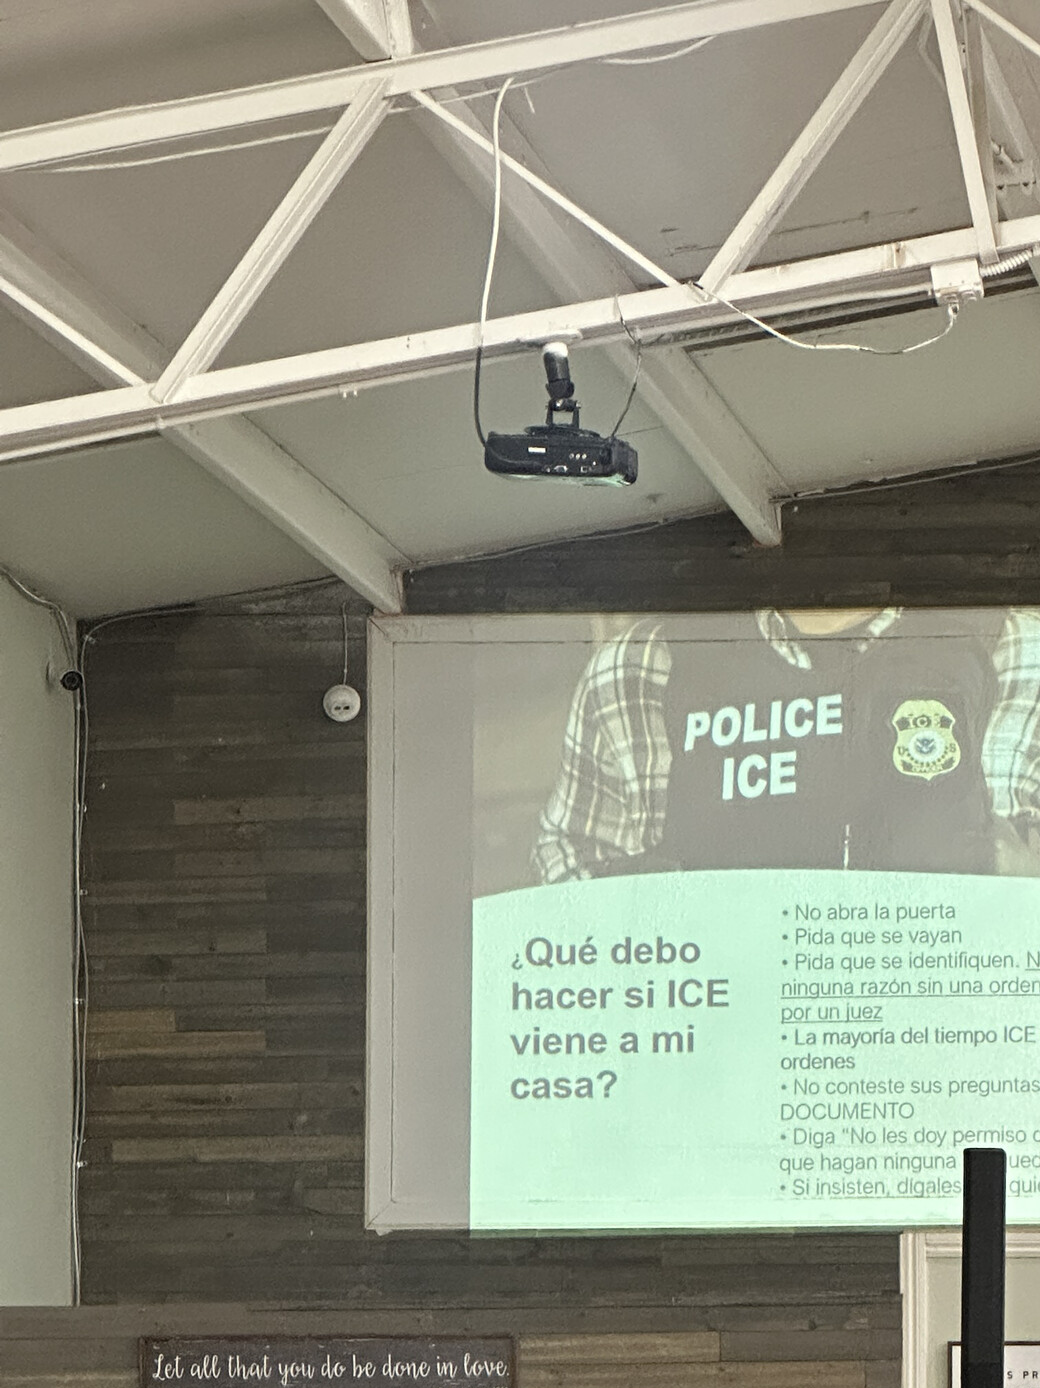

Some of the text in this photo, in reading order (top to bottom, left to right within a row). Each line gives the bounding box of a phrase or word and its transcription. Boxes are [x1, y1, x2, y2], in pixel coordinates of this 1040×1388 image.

[683, 694, 843, 751] POLICE
[722, 751, 797, 800] ICE
[795, 904, 956, 923] No abra la puerta
[795, 928, 962, 948] Pida que se vayan
[512, 936, 701, 970] ¿Qué debo
[795, 953, 835, 970] Pida
[841, 956, 876, 973] que
[881, 956, 903, 968] se
[909, 951, 1020, 972] identifiquen.
[512, 979, 729, 1010] hacer si ICE
[781, 979, 853, 998] ninguna
[860, 977, 911, 994] razón
[917, 976, 942, 993] sin
[950, 980, 982, 993] una
[781, 1004, 883, 1023] por un juez
[510, 1024, 694, 1055] viene a mi
[794, 1028, 816, 1045] La
[823, 1027, 895, 1047] mayoría
[901, 1027, 928, 1044] del
[934, 1027, 997, 1046] tiempo
[1003, 1026, 1036, 1043] ICE
[780, 1053, 856, 1070] ordenes
[510, 1070, 618, 1099] casa?
[793, 1078, 820, 1095] No
[825, 1078, 904, 1094] conteste
[910, 1080, 942, 1093] sus
[780, 1102, 915, 1121] DOCUMENTO
[793, 1128, 835, 1148] Diga
[882, 1127, 907, 1143] les
[913, 1127, 947, 1147] doy
[953, 1127, 1027, 1148] permiso
[780, 1155, 814, 1174] que
[821, 1154, 877, 1174] hagan
[884, 1153, 956, 1173] ninguna
[792, 1179, 812, 1195] Si
[816, 1178, 890, 1196] insisten,
[897, 1178, 962, 1198] dígales
[152, 1352, 510, 1386] Let all that you do be done in love.
